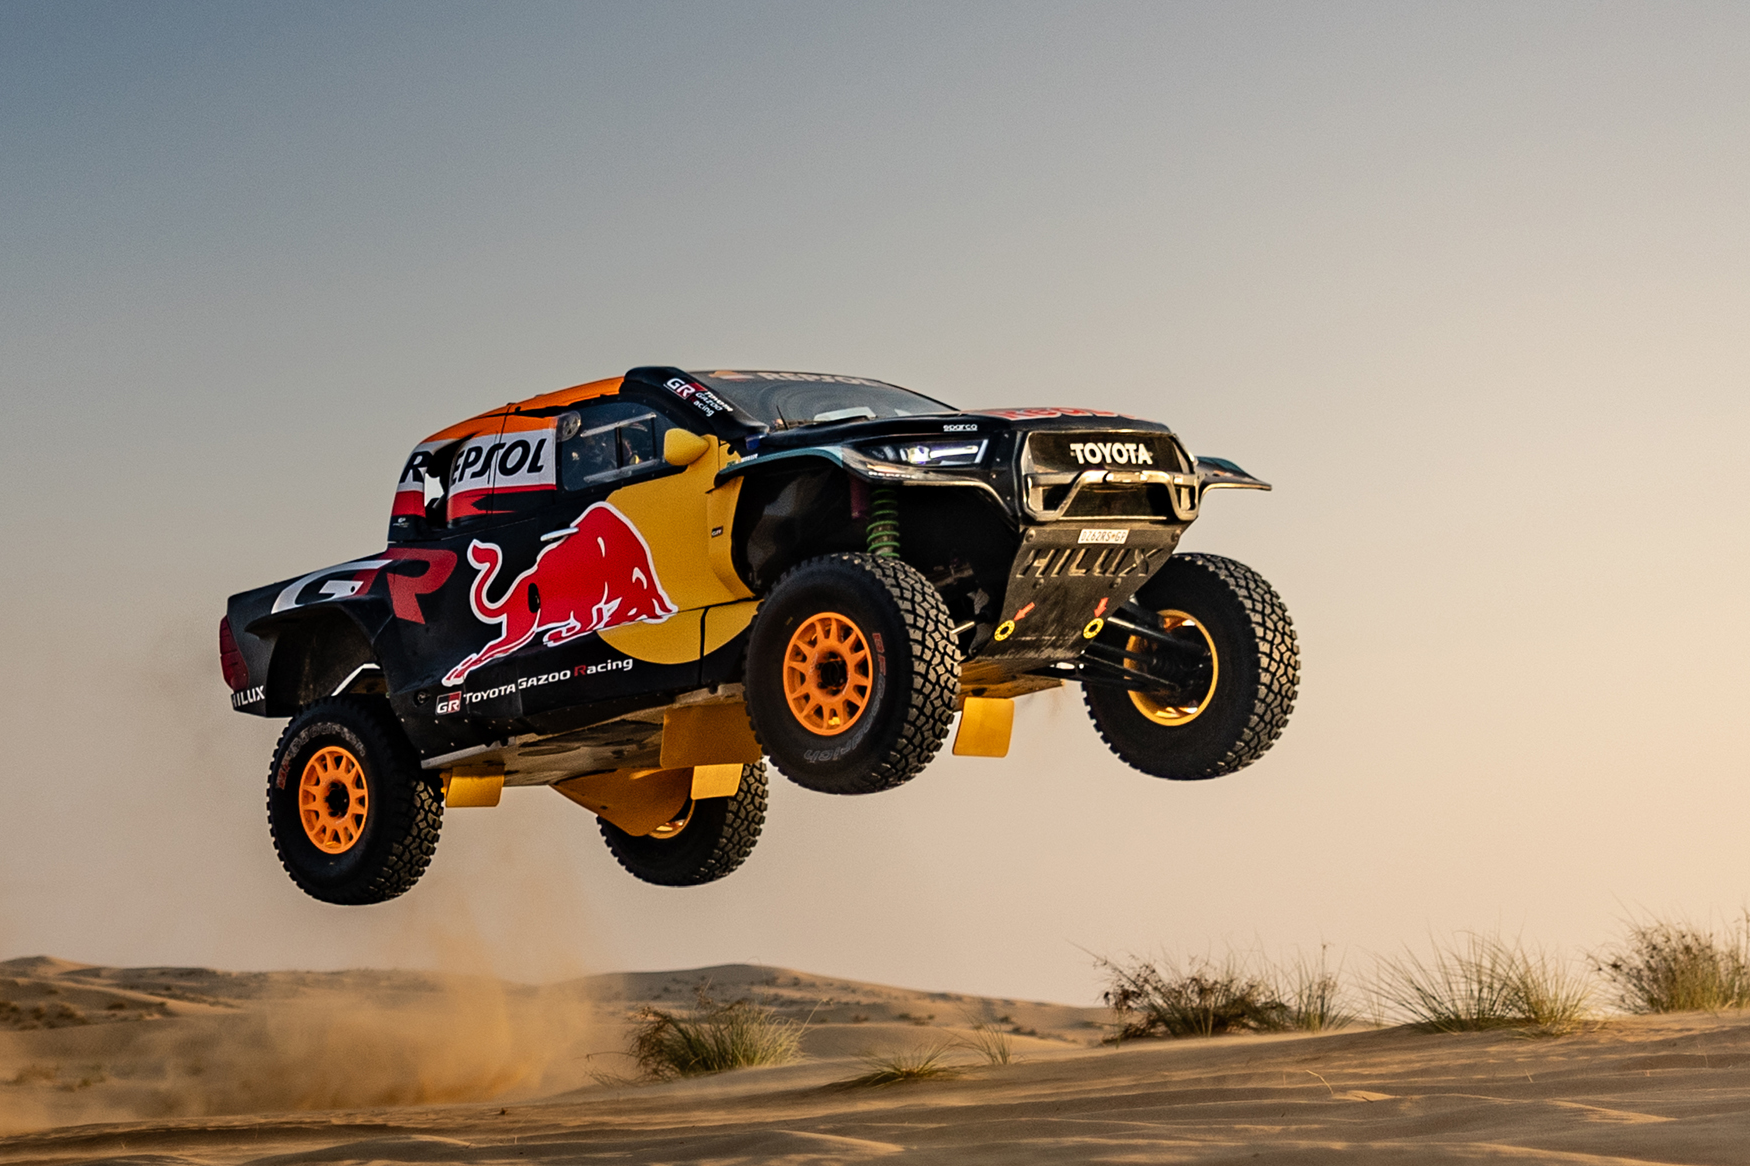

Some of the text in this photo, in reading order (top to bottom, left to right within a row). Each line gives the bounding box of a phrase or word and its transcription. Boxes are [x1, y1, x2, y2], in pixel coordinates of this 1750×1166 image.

[666, 377, 696, 398] GR
[399, 438, 547, 485] REPSOL
[1070, 442, 1153, 465] TOYOTA
[1015, 549, 1164, 578] HILUX
[463, 683, 516, 704] TOYOTA
[517, 670, 571, 689] GAZOO
[574, 658, 634, 677] Racing
